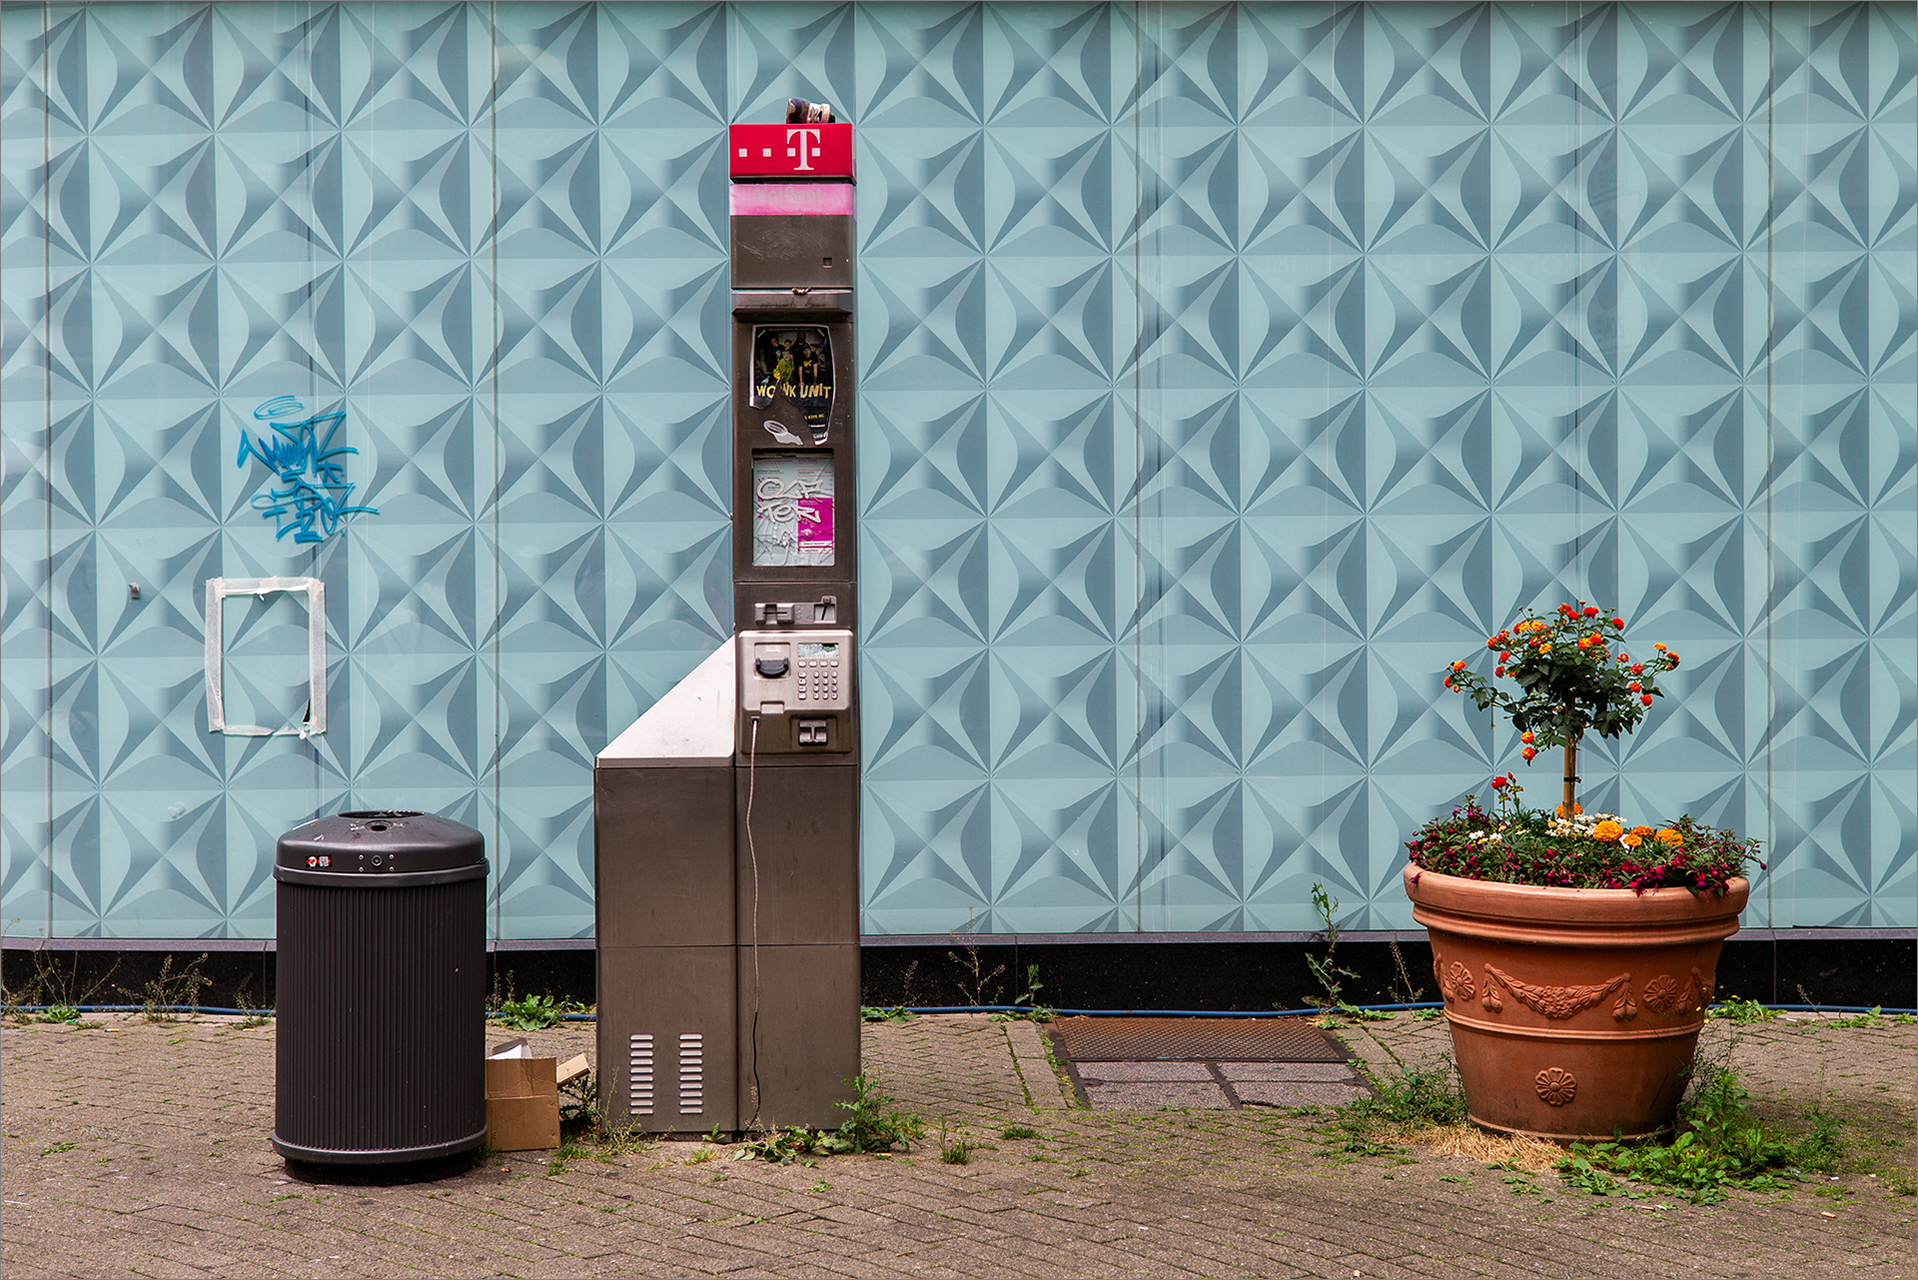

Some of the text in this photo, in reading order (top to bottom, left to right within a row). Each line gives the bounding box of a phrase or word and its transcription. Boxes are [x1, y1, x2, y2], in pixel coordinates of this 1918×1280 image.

[786, 128, 821, 171] T
[755, 186, 822, 206] HotSpot
[800, 383, 831, 399] UNIT
